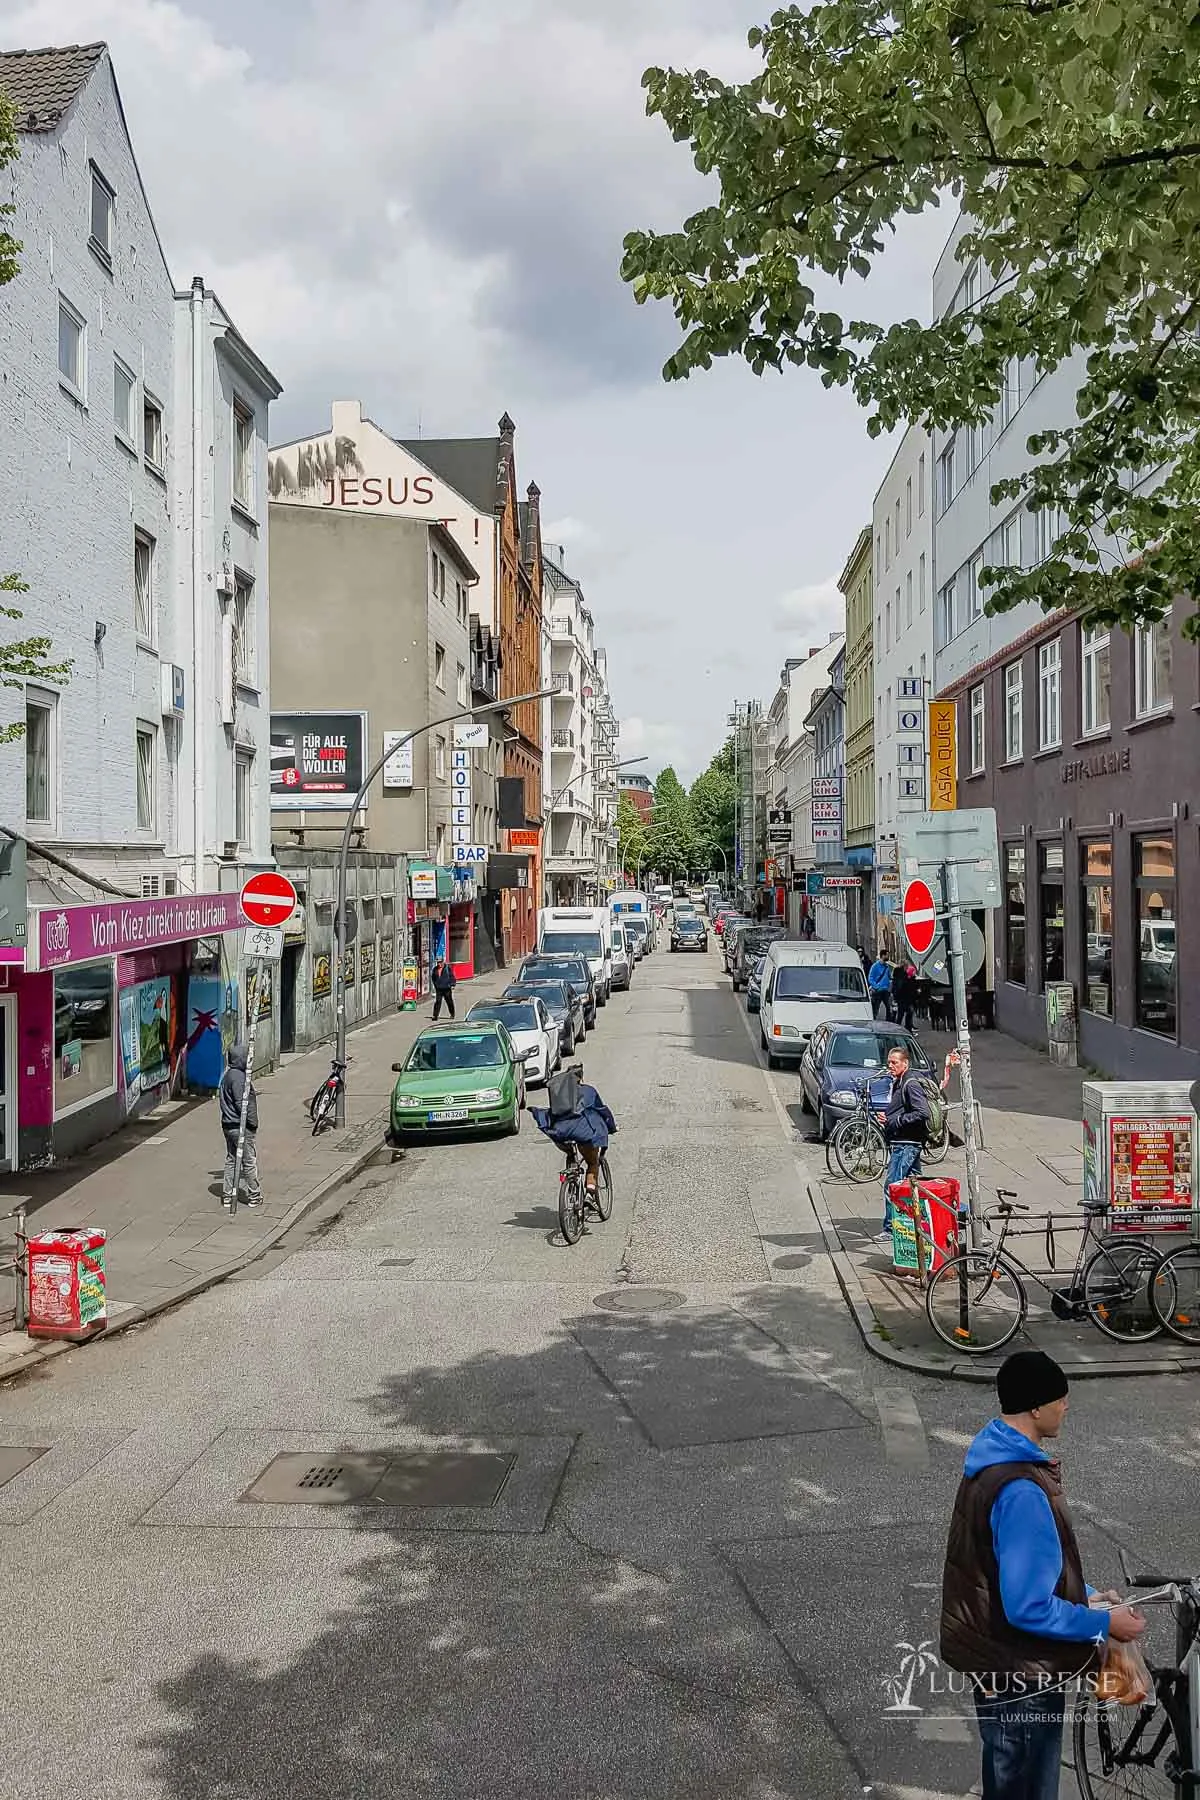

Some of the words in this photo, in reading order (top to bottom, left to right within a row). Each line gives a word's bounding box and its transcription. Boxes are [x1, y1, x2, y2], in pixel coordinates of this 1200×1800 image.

[322, 476, 434, 506] JESUS
[302, 732, 321, 748] FÜR
[465, 726, 483, 739] Pauli
[902, 680, 918, 796] HOTE
[302, 748, 318, 760] DIE
[319, 748, 346, 760] MEHR
[303, 760, 346, 774] WOLLEN
[455, 753, 465, 842] HOTEL
[814, 787, 839, 795] KINO
[457, 847, 486, 861] BAR
[91, 912, 118, 949] Vom
[146, 905, 174, 938] direkt
[175, 903, 184, 933] in
[185, 902, 200, 931] den
